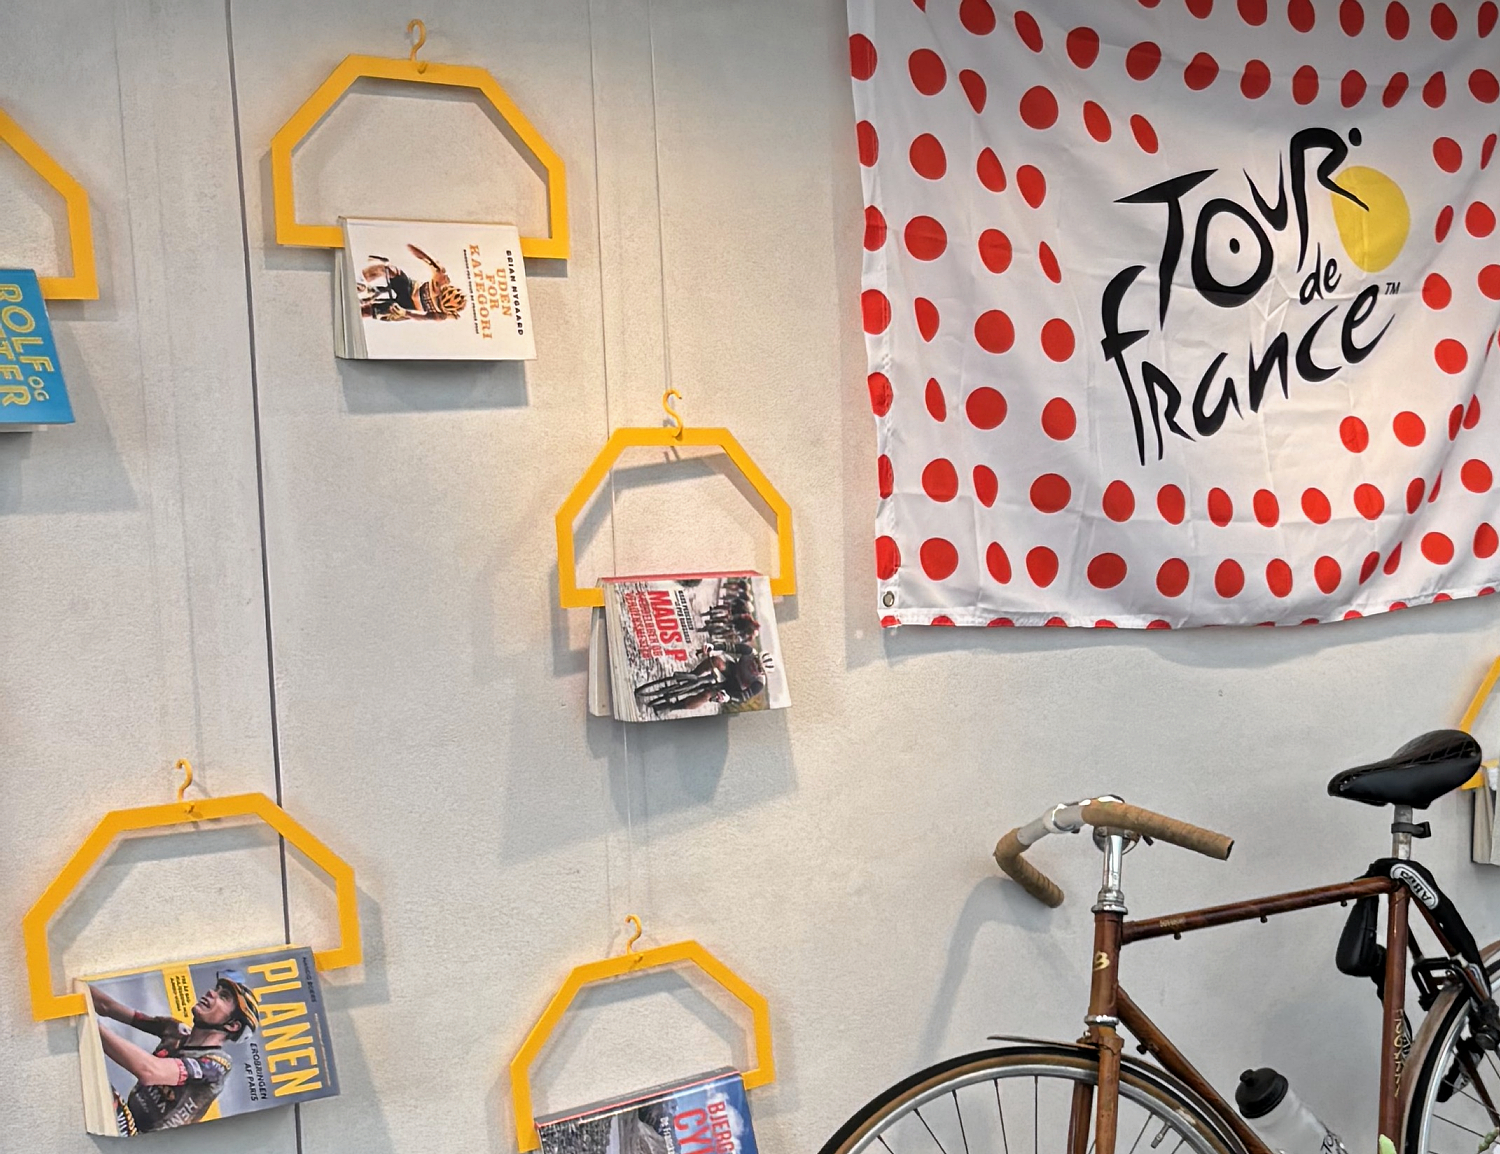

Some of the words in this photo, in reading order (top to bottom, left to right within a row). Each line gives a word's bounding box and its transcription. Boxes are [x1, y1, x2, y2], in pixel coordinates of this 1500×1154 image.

[469, 244, 493, 340] KATEGORI
[485, 274, 500, 310] FOR
[496, 268, 513, 317] UDEN
[1299, 243, 1341, 306] de
[511, 286, 524, 336] NYGAARD
[647, 590, 683, 646] MADS
[664, 649, 689, 663] P
[247, 958, 322, 1097] PLANEN
[244, 1063, 253, 1075] AF
[247, 1076, 258, 1102] PARIS
[250, 1042, 268, 1101] EROBRINGEN
